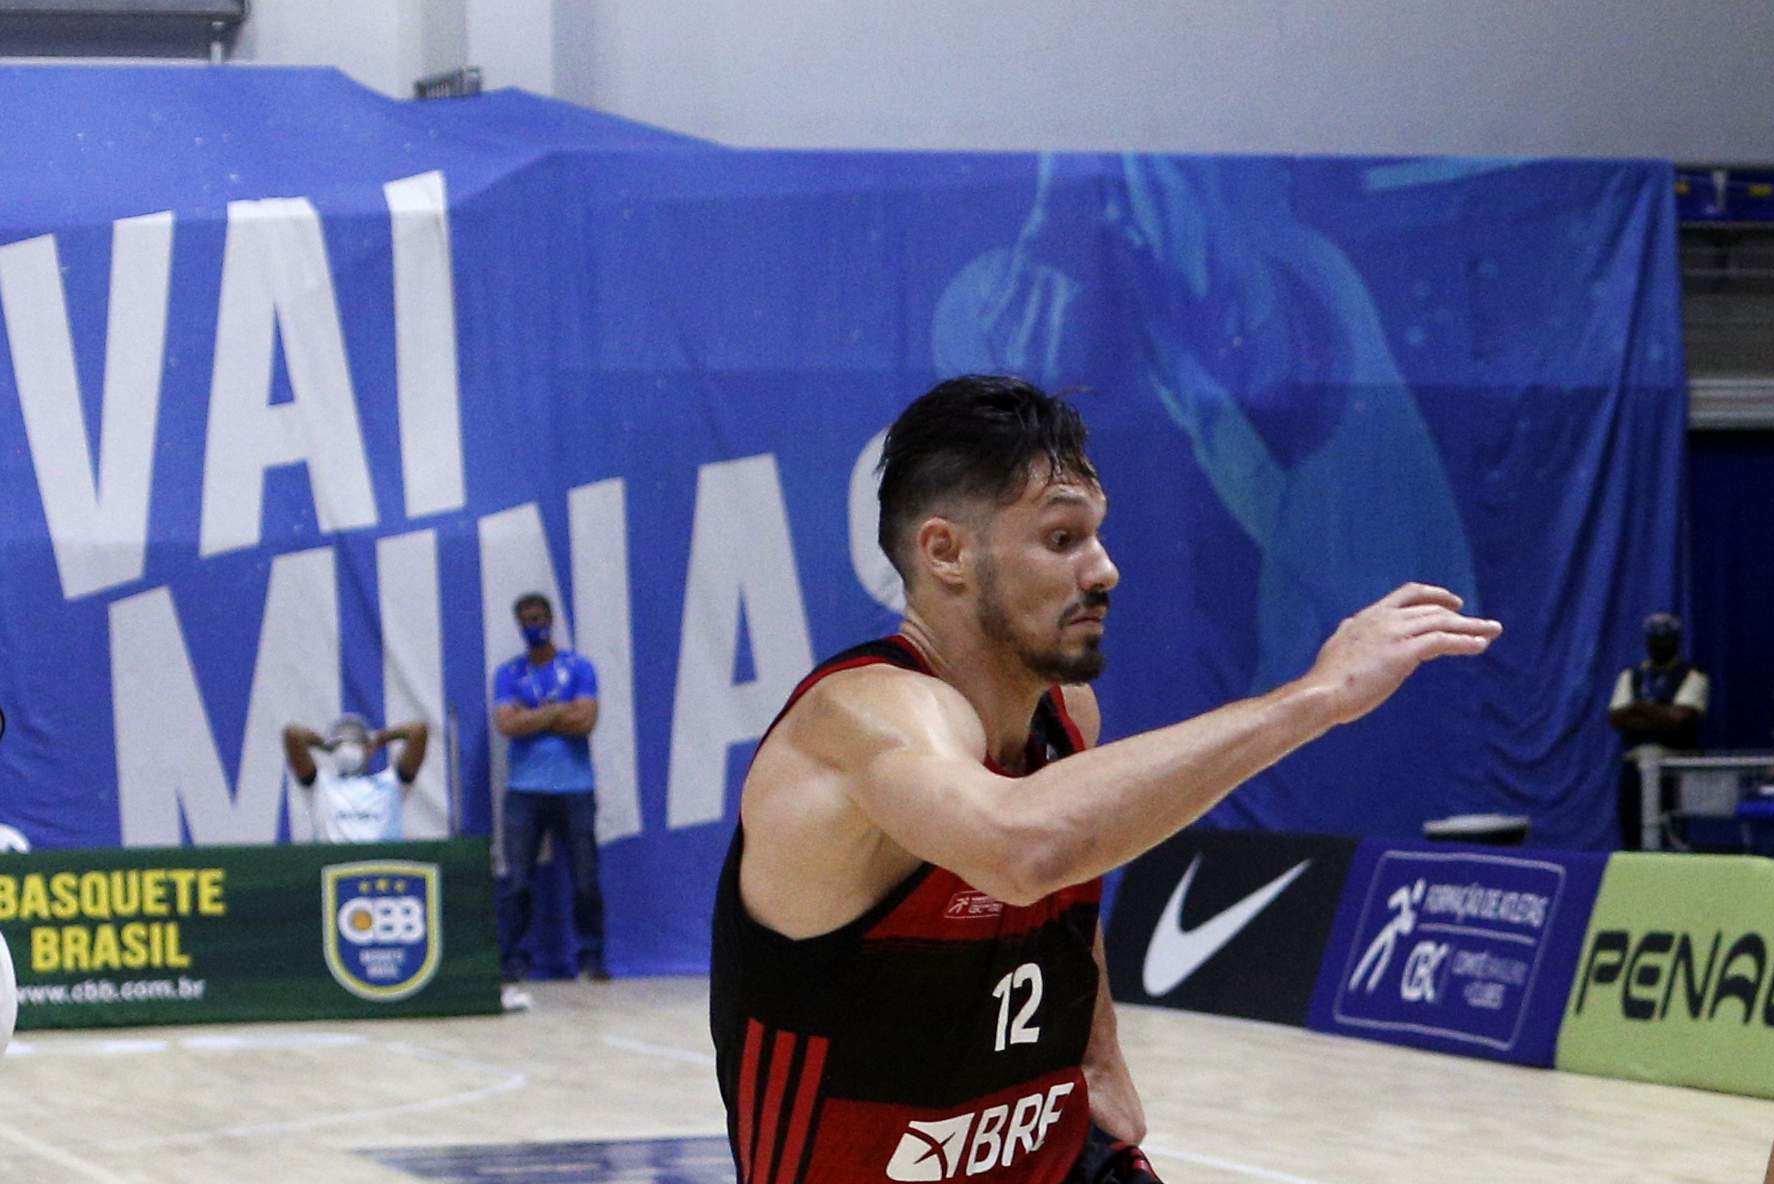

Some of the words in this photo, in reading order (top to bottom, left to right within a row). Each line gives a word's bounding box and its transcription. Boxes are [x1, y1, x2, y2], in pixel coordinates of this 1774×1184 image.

[0, 170, 466, 600] VAI
[31, 920, 191, 973] BRASIL
[337, 896, 426, 945] CBB
[991, 961, 1044, 1052] 12
[966, 1081, 1076, 1177] BRF
